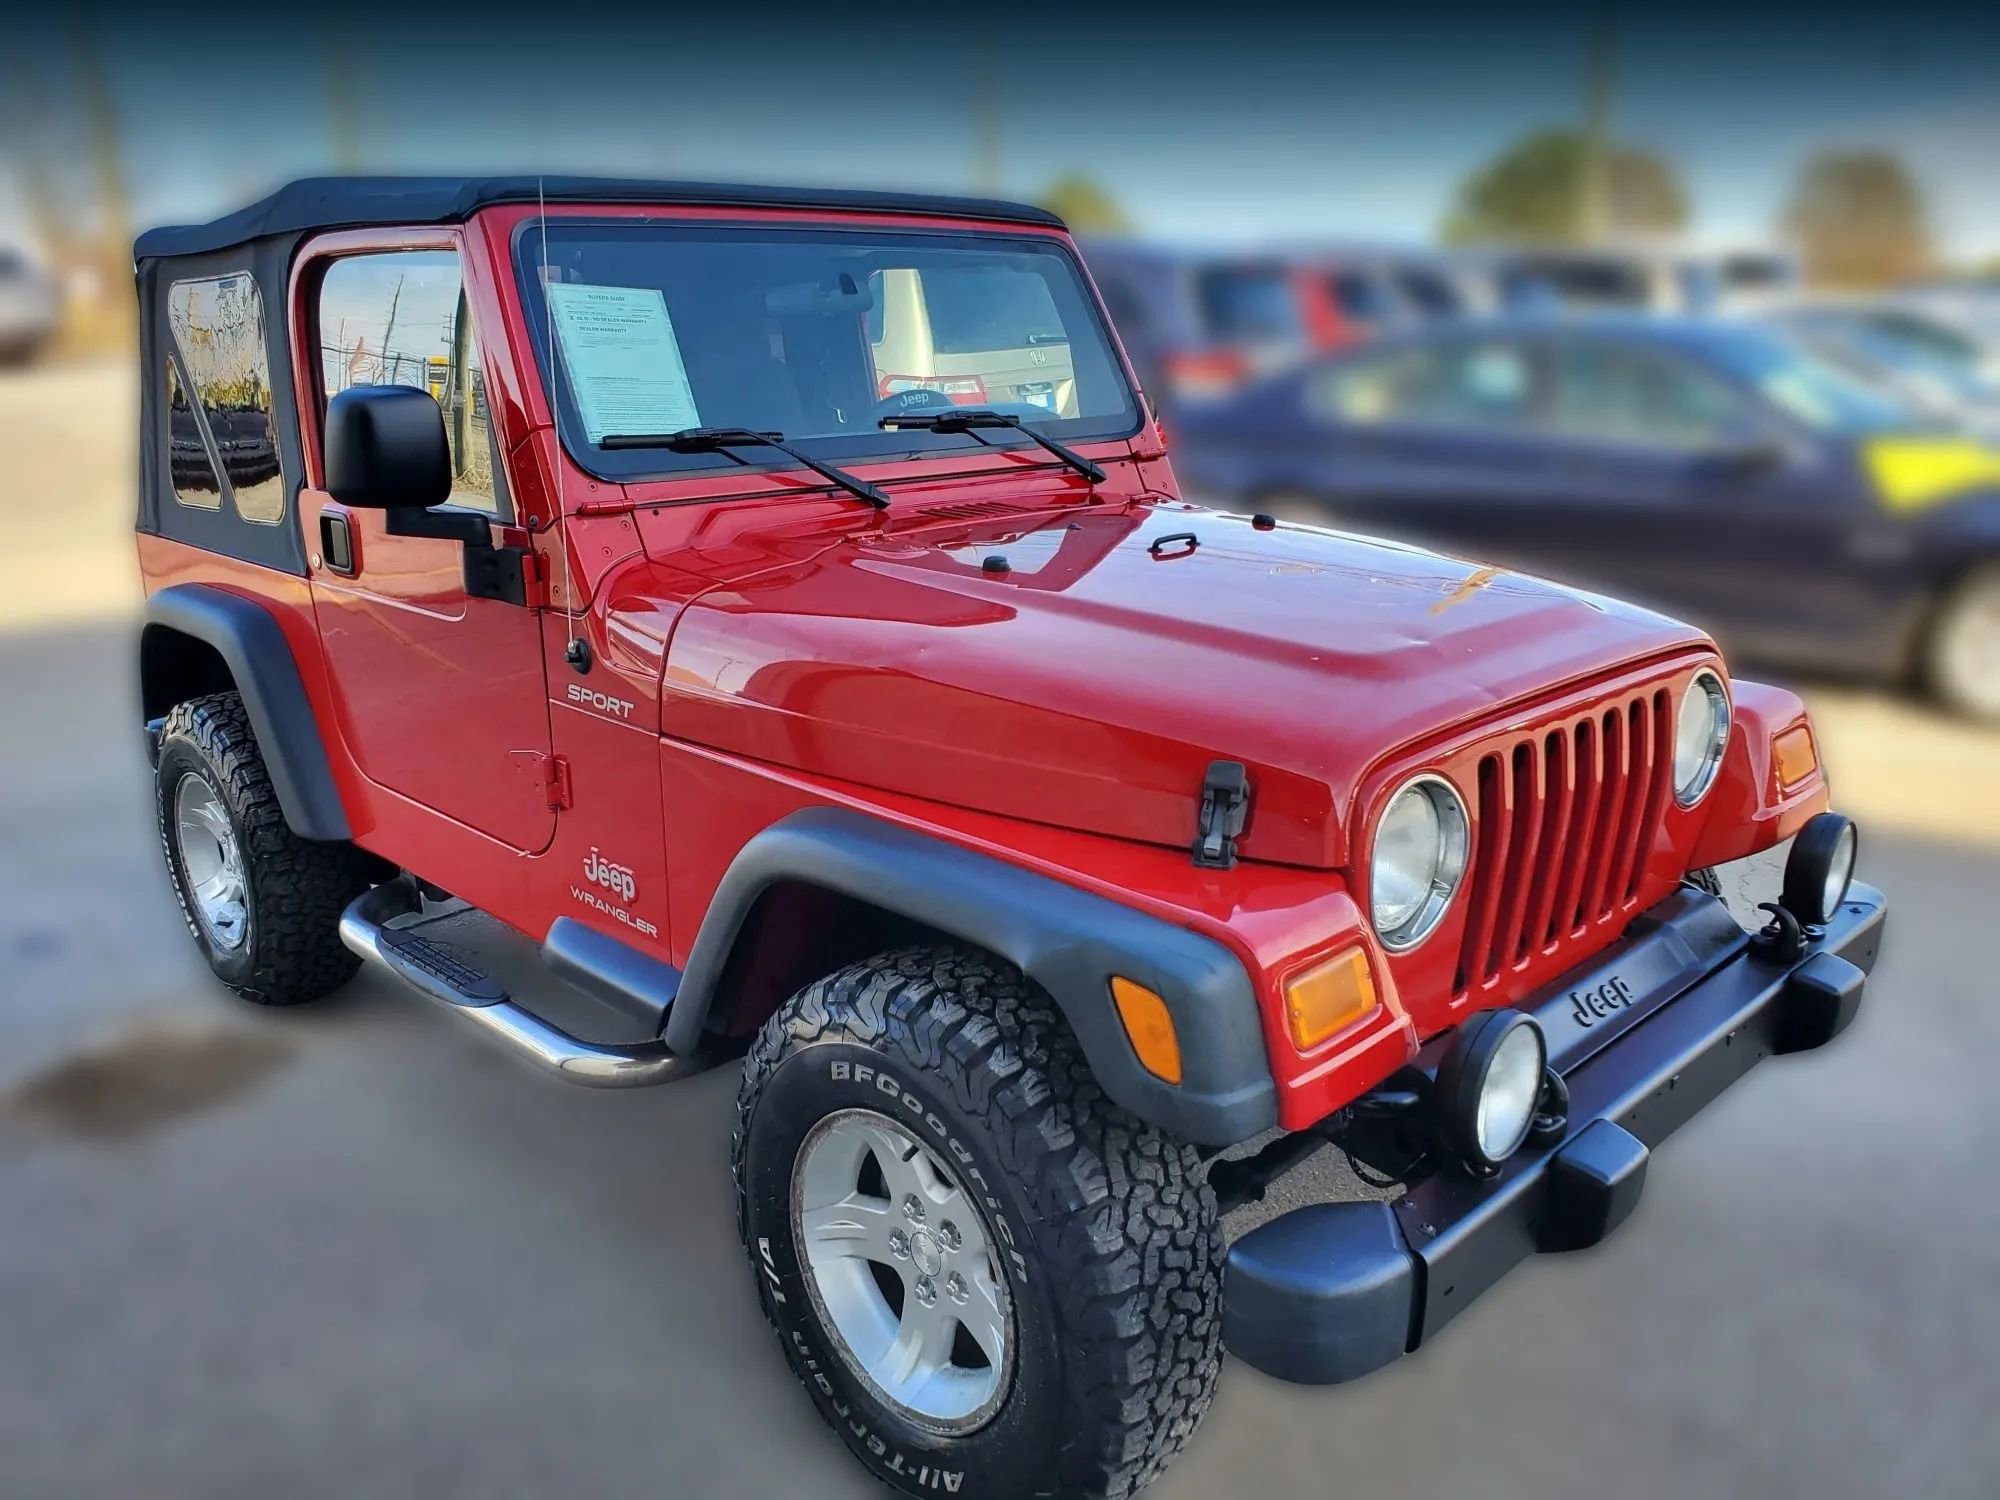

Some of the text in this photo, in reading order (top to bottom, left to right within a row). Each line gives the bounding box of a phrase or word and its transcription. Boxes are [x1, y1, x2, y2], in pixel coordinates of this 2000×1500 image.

[899, 393, 929, 407] Jeep
[567, 683, 635, 719] SPORT
[583, 846, 635, 902] Jeep
[570, 884, 658, 939] WRANGLER
[1568, 975, 1633, 1028] Jeep
[830, 1060, 1027, 1284] BFGoodrich
[758, 1237, 965, 1493] All-Terrain T/A
